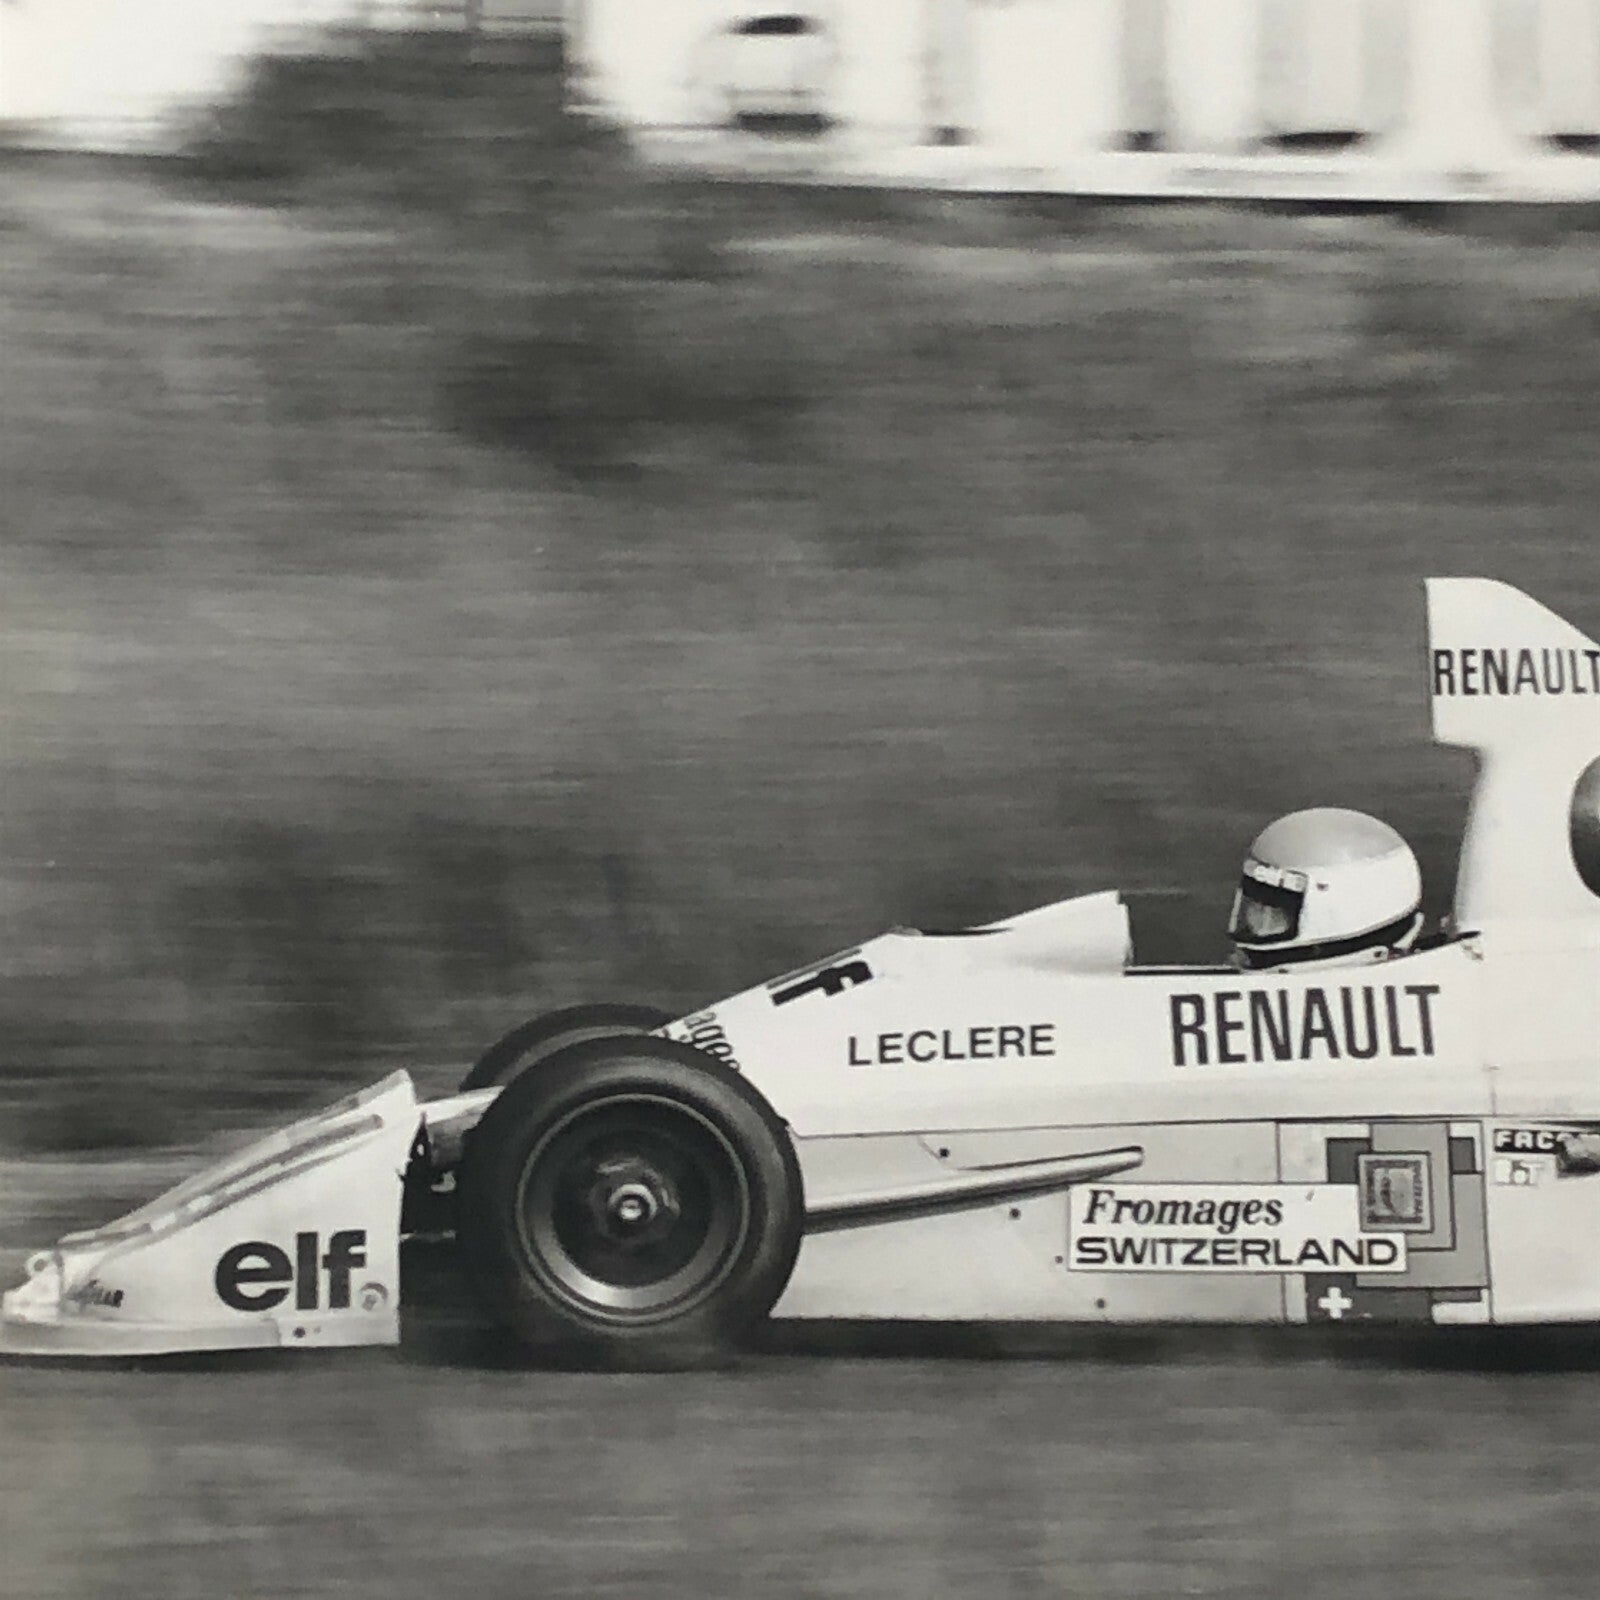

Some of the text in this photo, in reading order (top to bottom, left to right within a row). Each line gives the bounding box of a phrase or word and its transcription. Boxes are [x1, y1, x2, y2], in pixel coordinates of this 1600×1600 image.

[1433, 648, 1600, 695] RENAULT
[848, 1023, 1056, 1066] LECLERE
[1170, 984, 1440, 1066] RENAULT
[1081, 1188, 1283, 1234] Fromages
[215, 1229, 367, 1312] elf
[1075, 1236, 1398, 1266] SWITZERLAND
